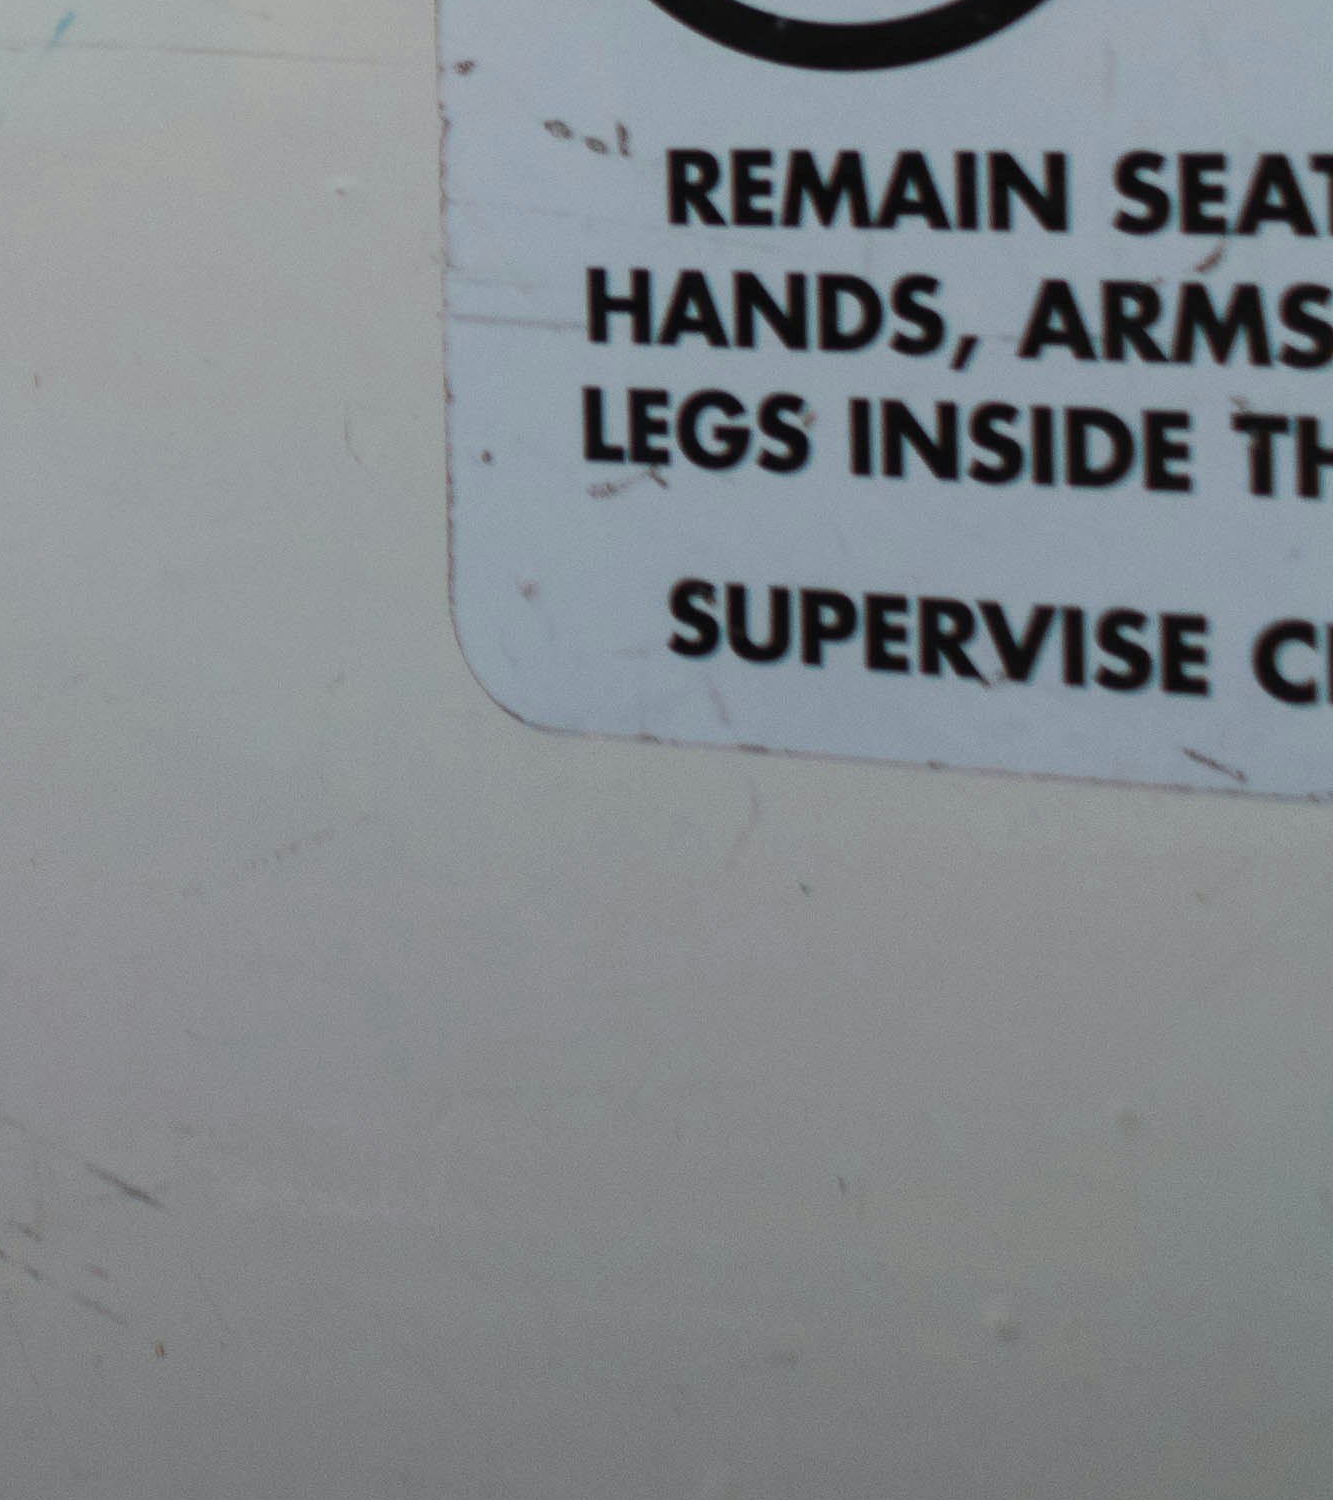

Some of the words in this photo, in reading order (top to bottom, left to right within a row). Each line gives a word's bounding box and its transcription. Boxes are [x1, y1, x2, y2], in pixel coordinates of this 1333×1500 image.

[667, 149, 1071, 233] REMAIN
[587, 267, 979, 371] HANDS,
[1018, 279, 1333, 370] ARMS
[583, 386, 812, 475] LEGS
[850, 398, 1193, 494] INSIDE
[669, 579, 1211, 697] SUPERVISE
[1252, 619, 1333, 707] C
